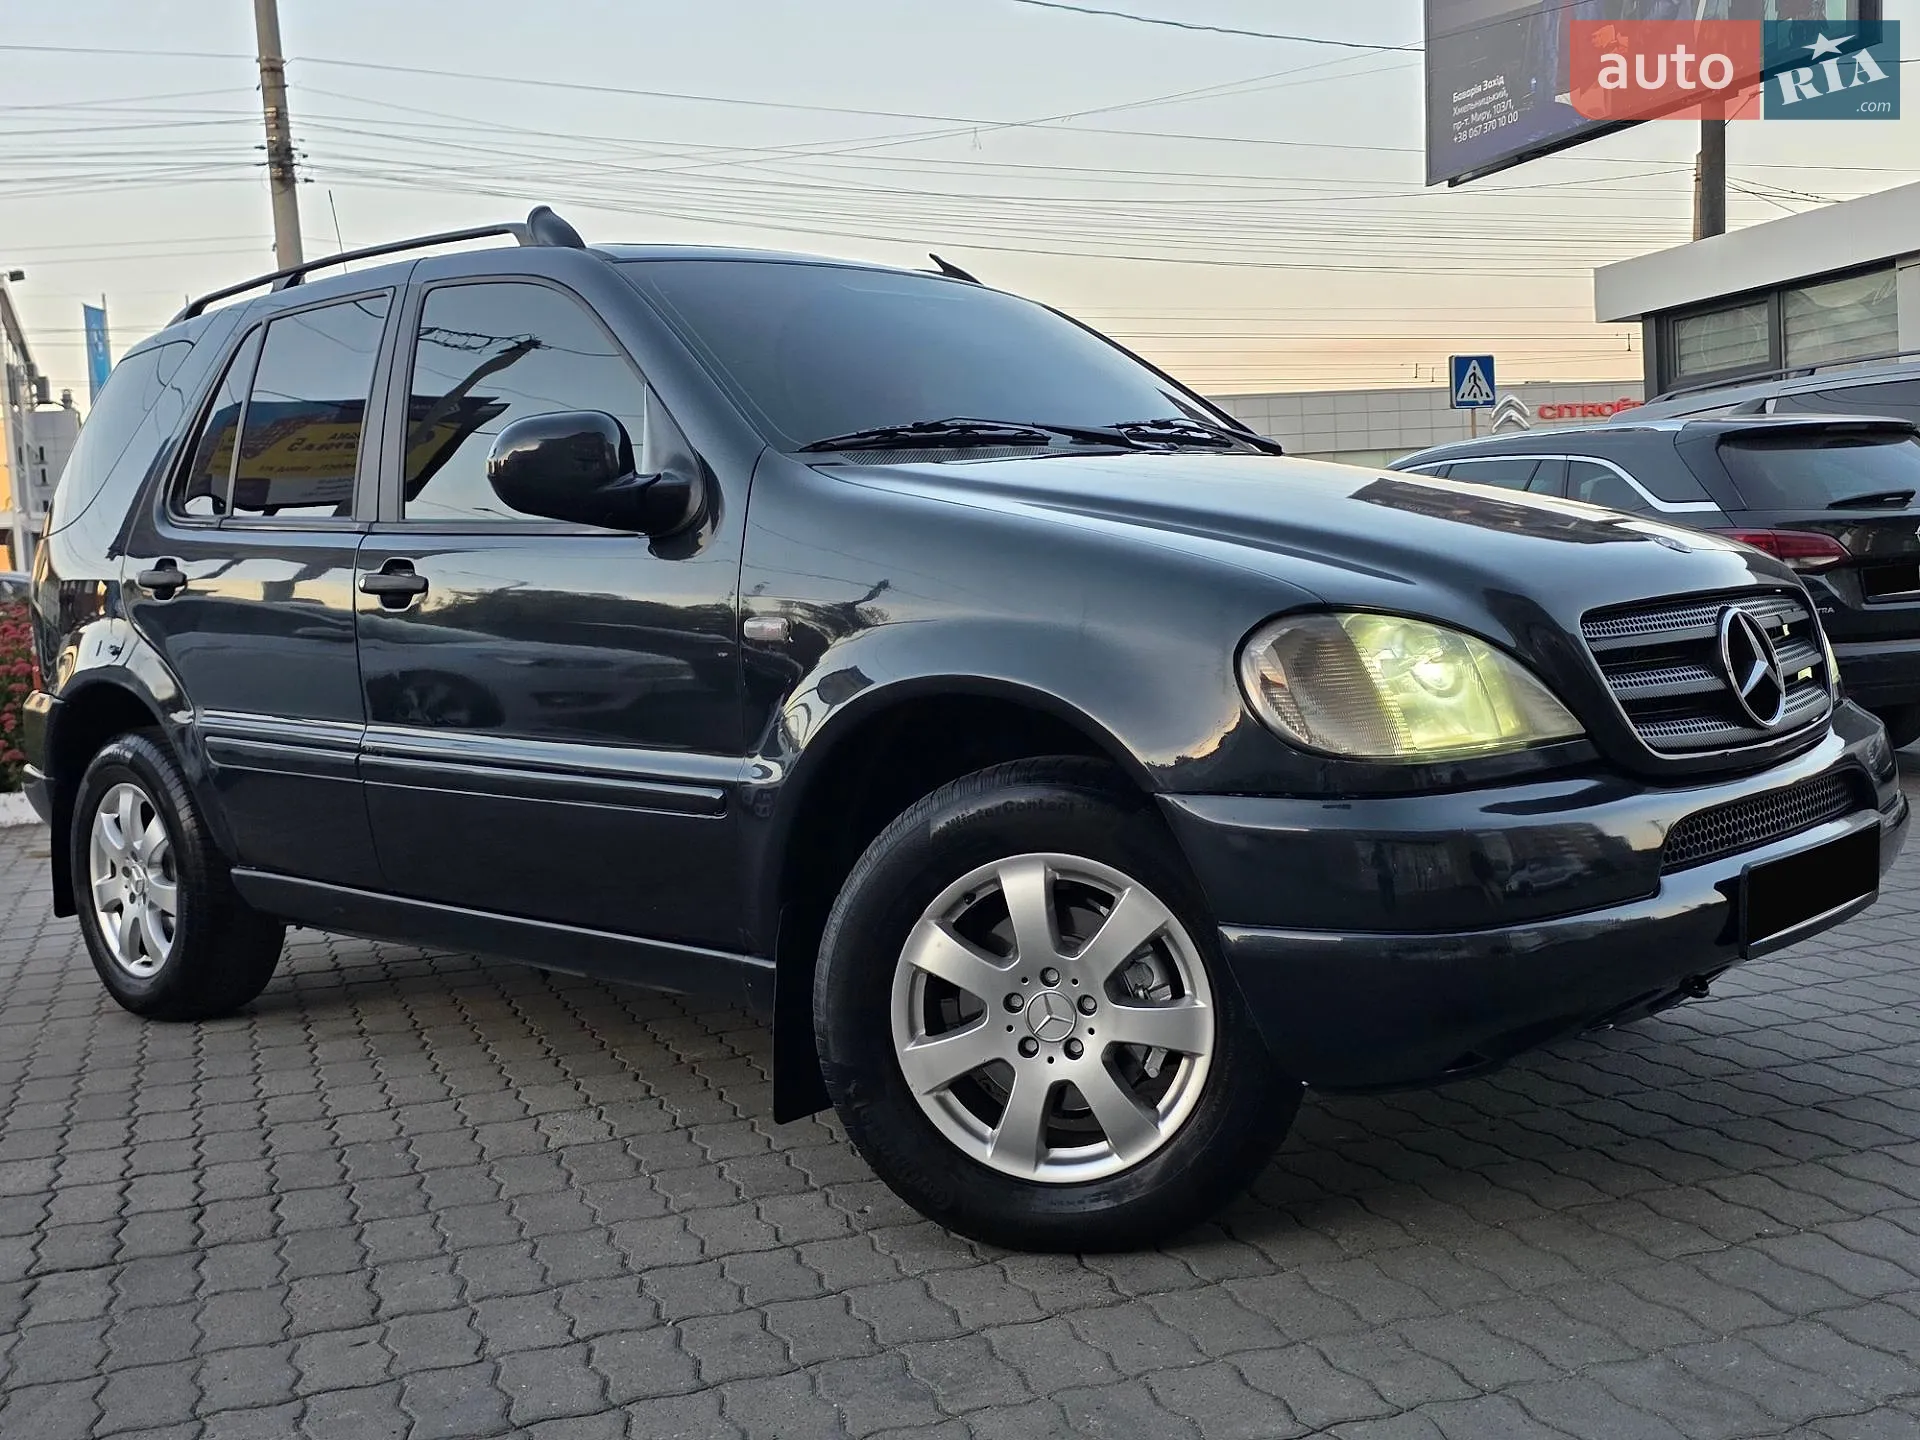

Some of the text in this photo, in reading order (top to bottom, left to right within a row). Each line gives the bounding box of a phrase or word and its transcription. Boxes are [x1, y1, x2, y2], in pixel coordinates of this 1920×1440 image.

[1482, 75, 1504, 91] Захід
[1453, 110, 1518, 143] +38 067 370 10 00
[1538, 396, 1642, 419] CITROË
